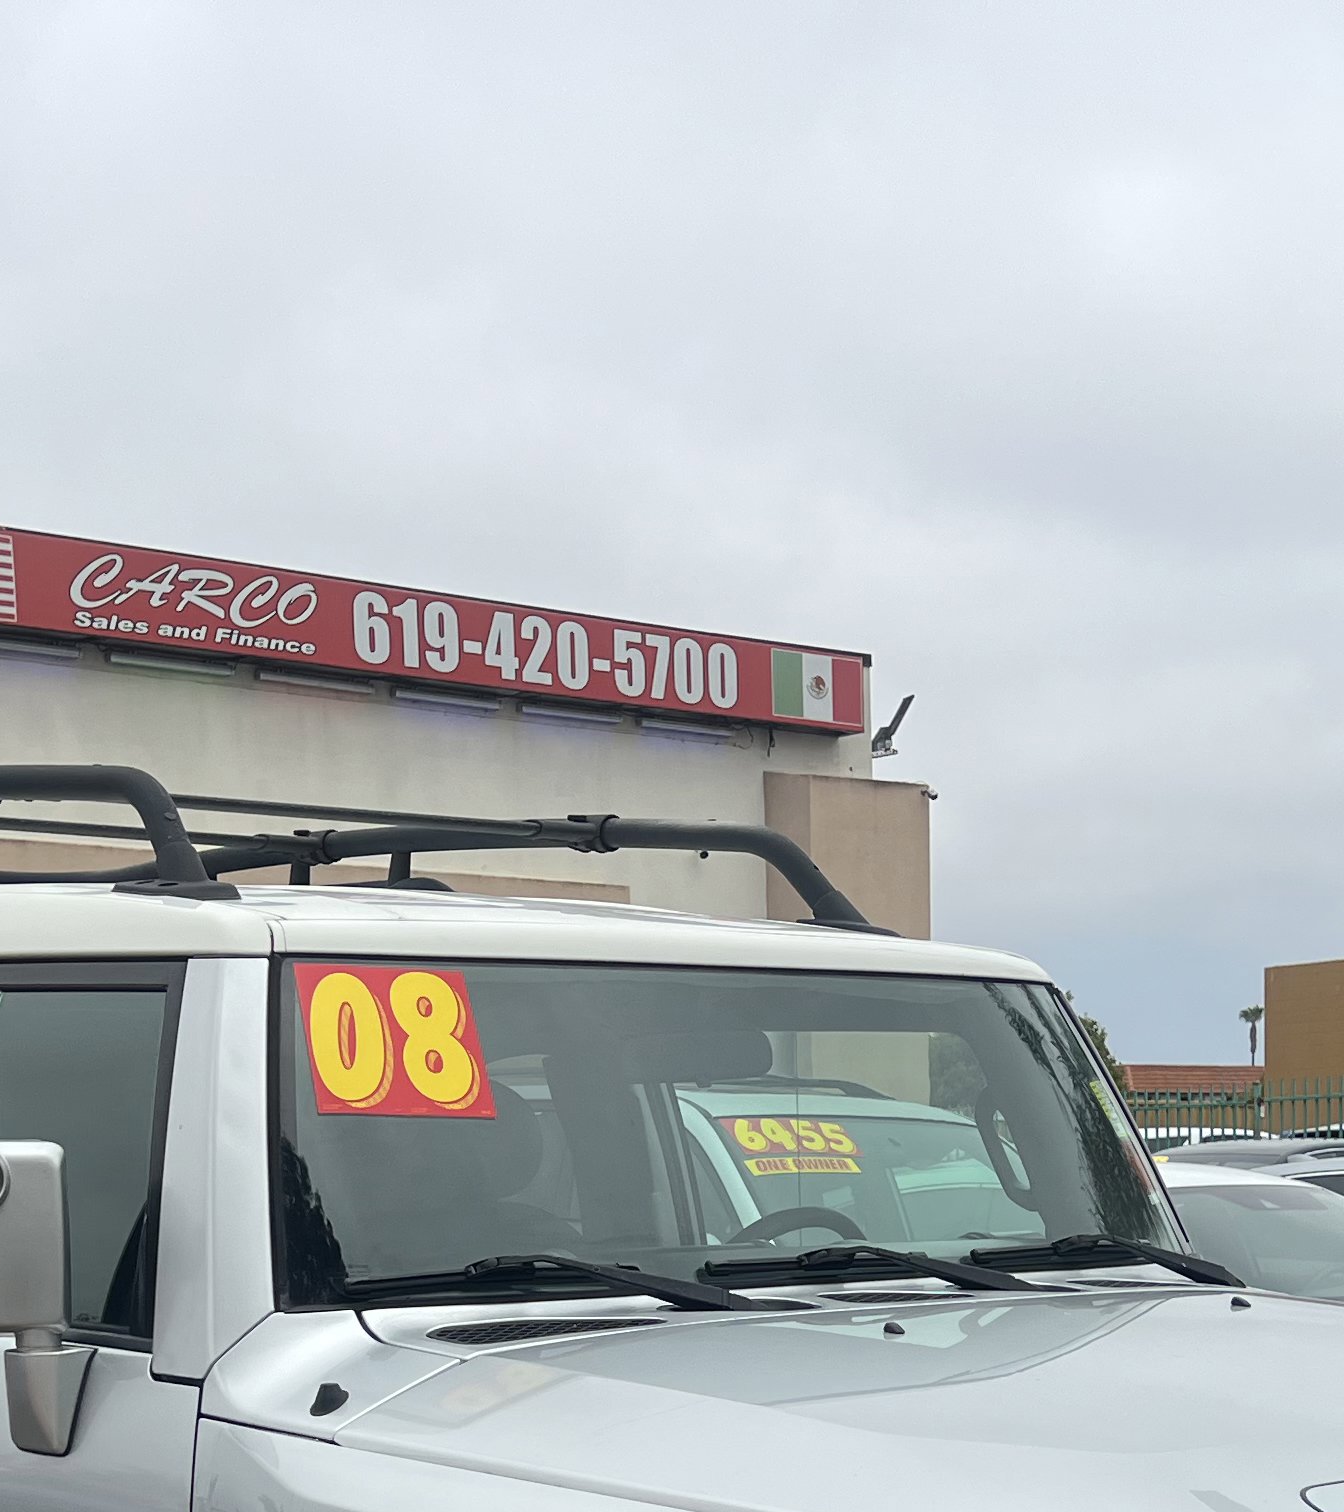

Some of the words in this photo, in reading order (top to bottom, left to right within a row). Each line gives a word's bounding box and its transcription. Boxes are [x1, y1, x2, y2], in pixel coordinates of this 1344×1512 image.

[69, 553, 318, 628] CARCO
[74, 611, 149, 634] Sales
[158, 624, 208, 641] and
[215, 628, 316, 654] Finance
[352, 590, 738, 709] 619-420-5700
[309, 970, 479, 1109] 08
[734, 1118, 856, 1153] 6455
[755, 1158, 791, 1173] ONE
[793, 1158, 852, 1172] OWNER
